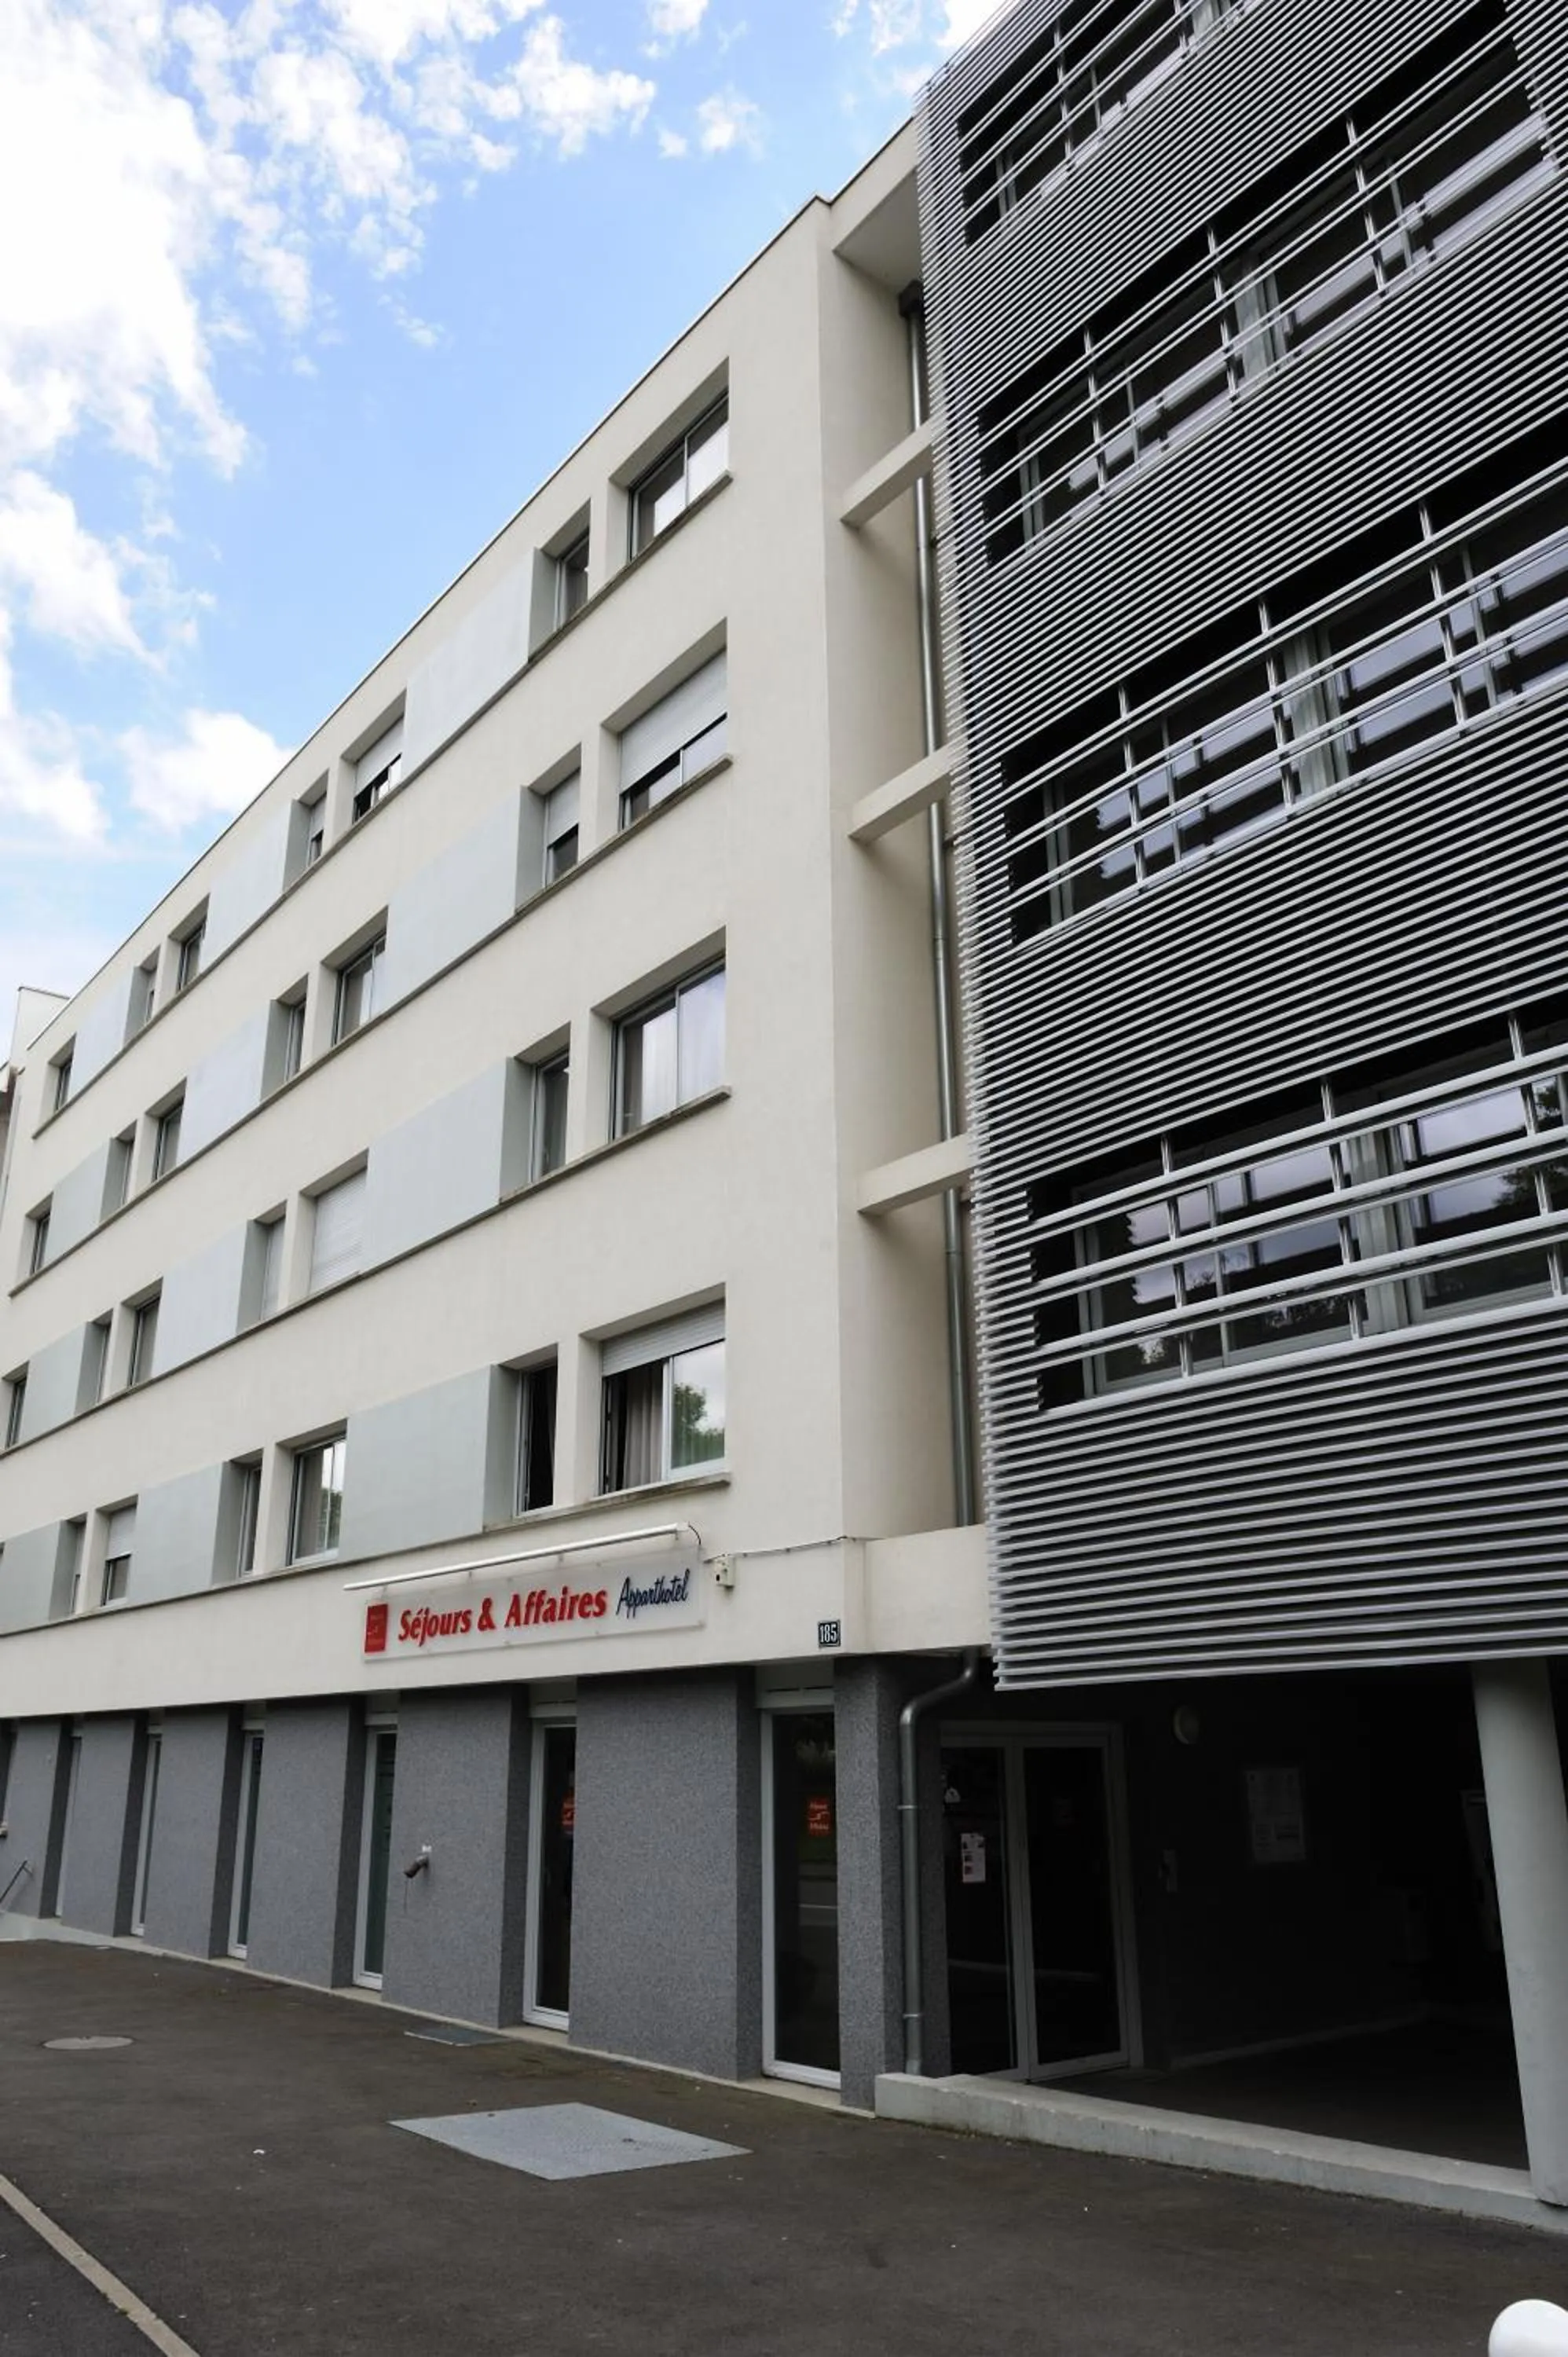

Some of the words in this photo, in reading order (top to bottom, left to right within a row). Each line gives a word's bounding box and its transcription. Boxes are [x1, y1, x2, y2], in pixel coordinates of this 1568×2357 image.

[397, 1607, 472, 1647] Séjours
[477, 1597, 496, 1632] &
[504, 1585, 608, 1629] Affaires
[819, 1624, 837, 1644] 185
